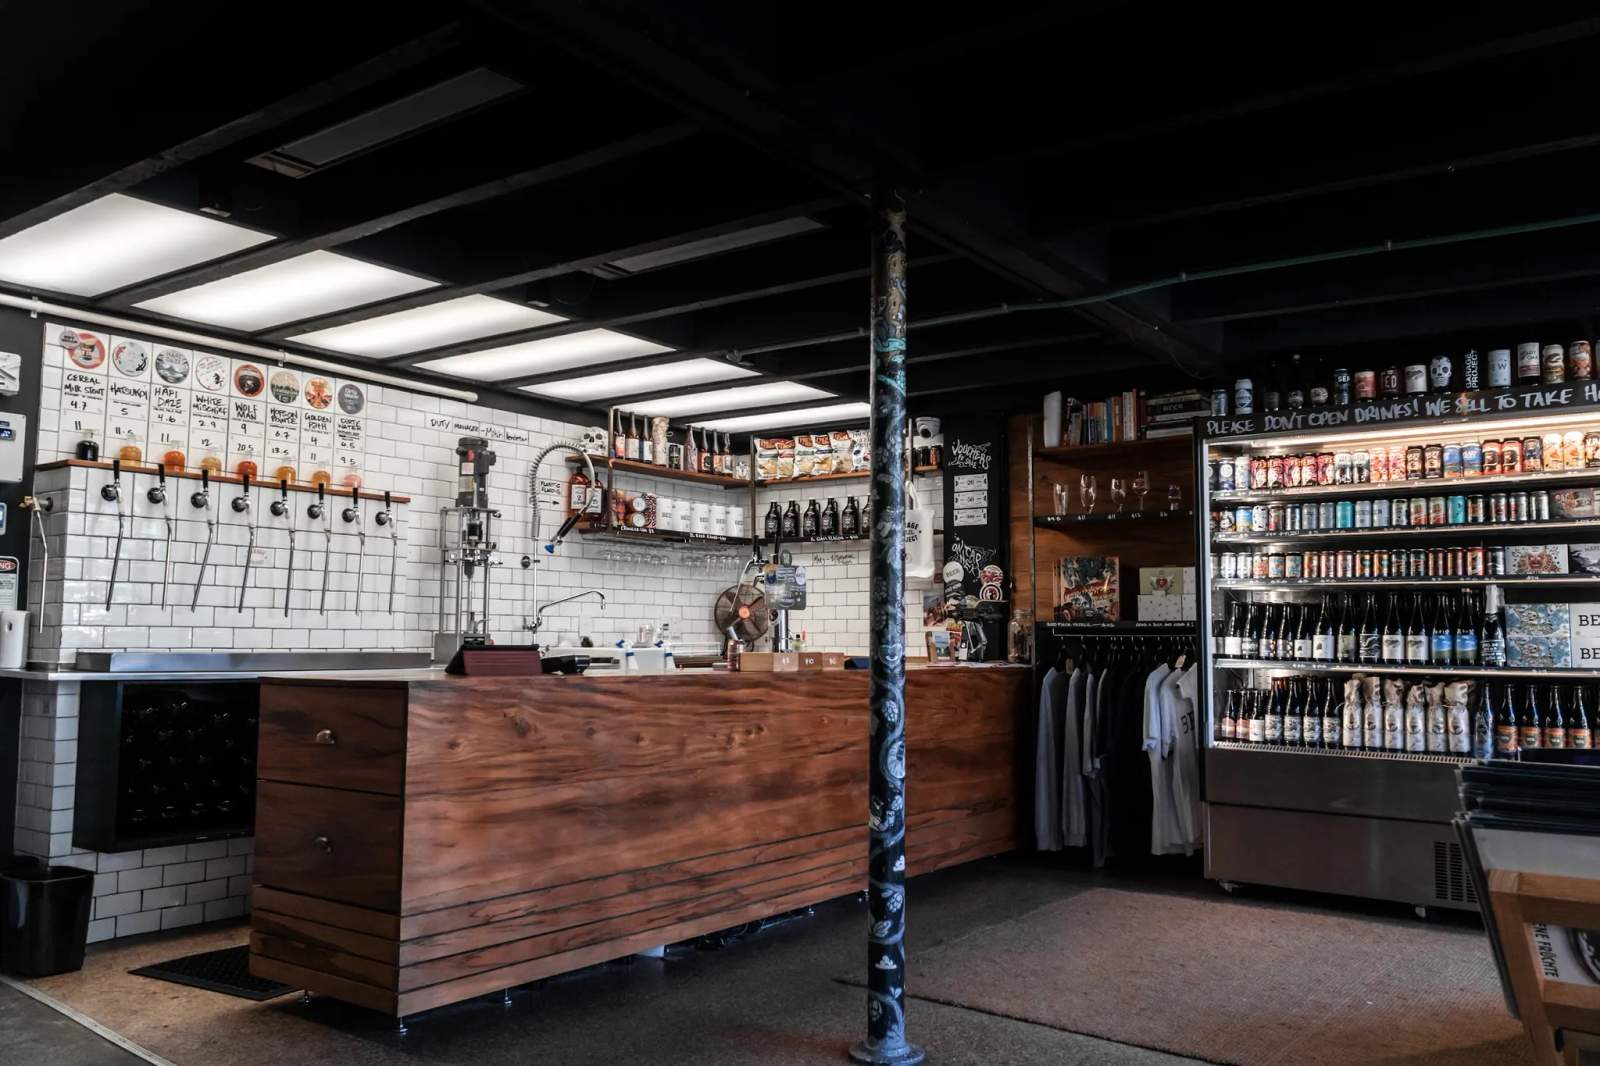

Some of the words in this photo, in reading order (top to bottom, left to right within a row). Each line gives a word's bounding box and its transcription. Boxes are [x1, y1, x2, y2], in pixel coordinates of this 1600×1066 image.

[66, 374, 100, 385] CEREAL
[158, 398, 182, 408] DAZE
[196, 395, 222, 406] WHITE
[237, 411, 256, 420] MAN
[1206, 420, 1256, 435] PLEASE
[1308, 410, 1349, 426] OPEN
[1354, 394, 1418, 423] DRINKS!
[1426, 397, 1450, 416] WE
[1456, 397, 1492, 414] SELL
[1495, 394, 1516, 410] TO
[1520, 388, 1574, 408] TAKE
[304, 412, 332, 423] GOLDEN
[430, 418, 450, 429] DUTY
